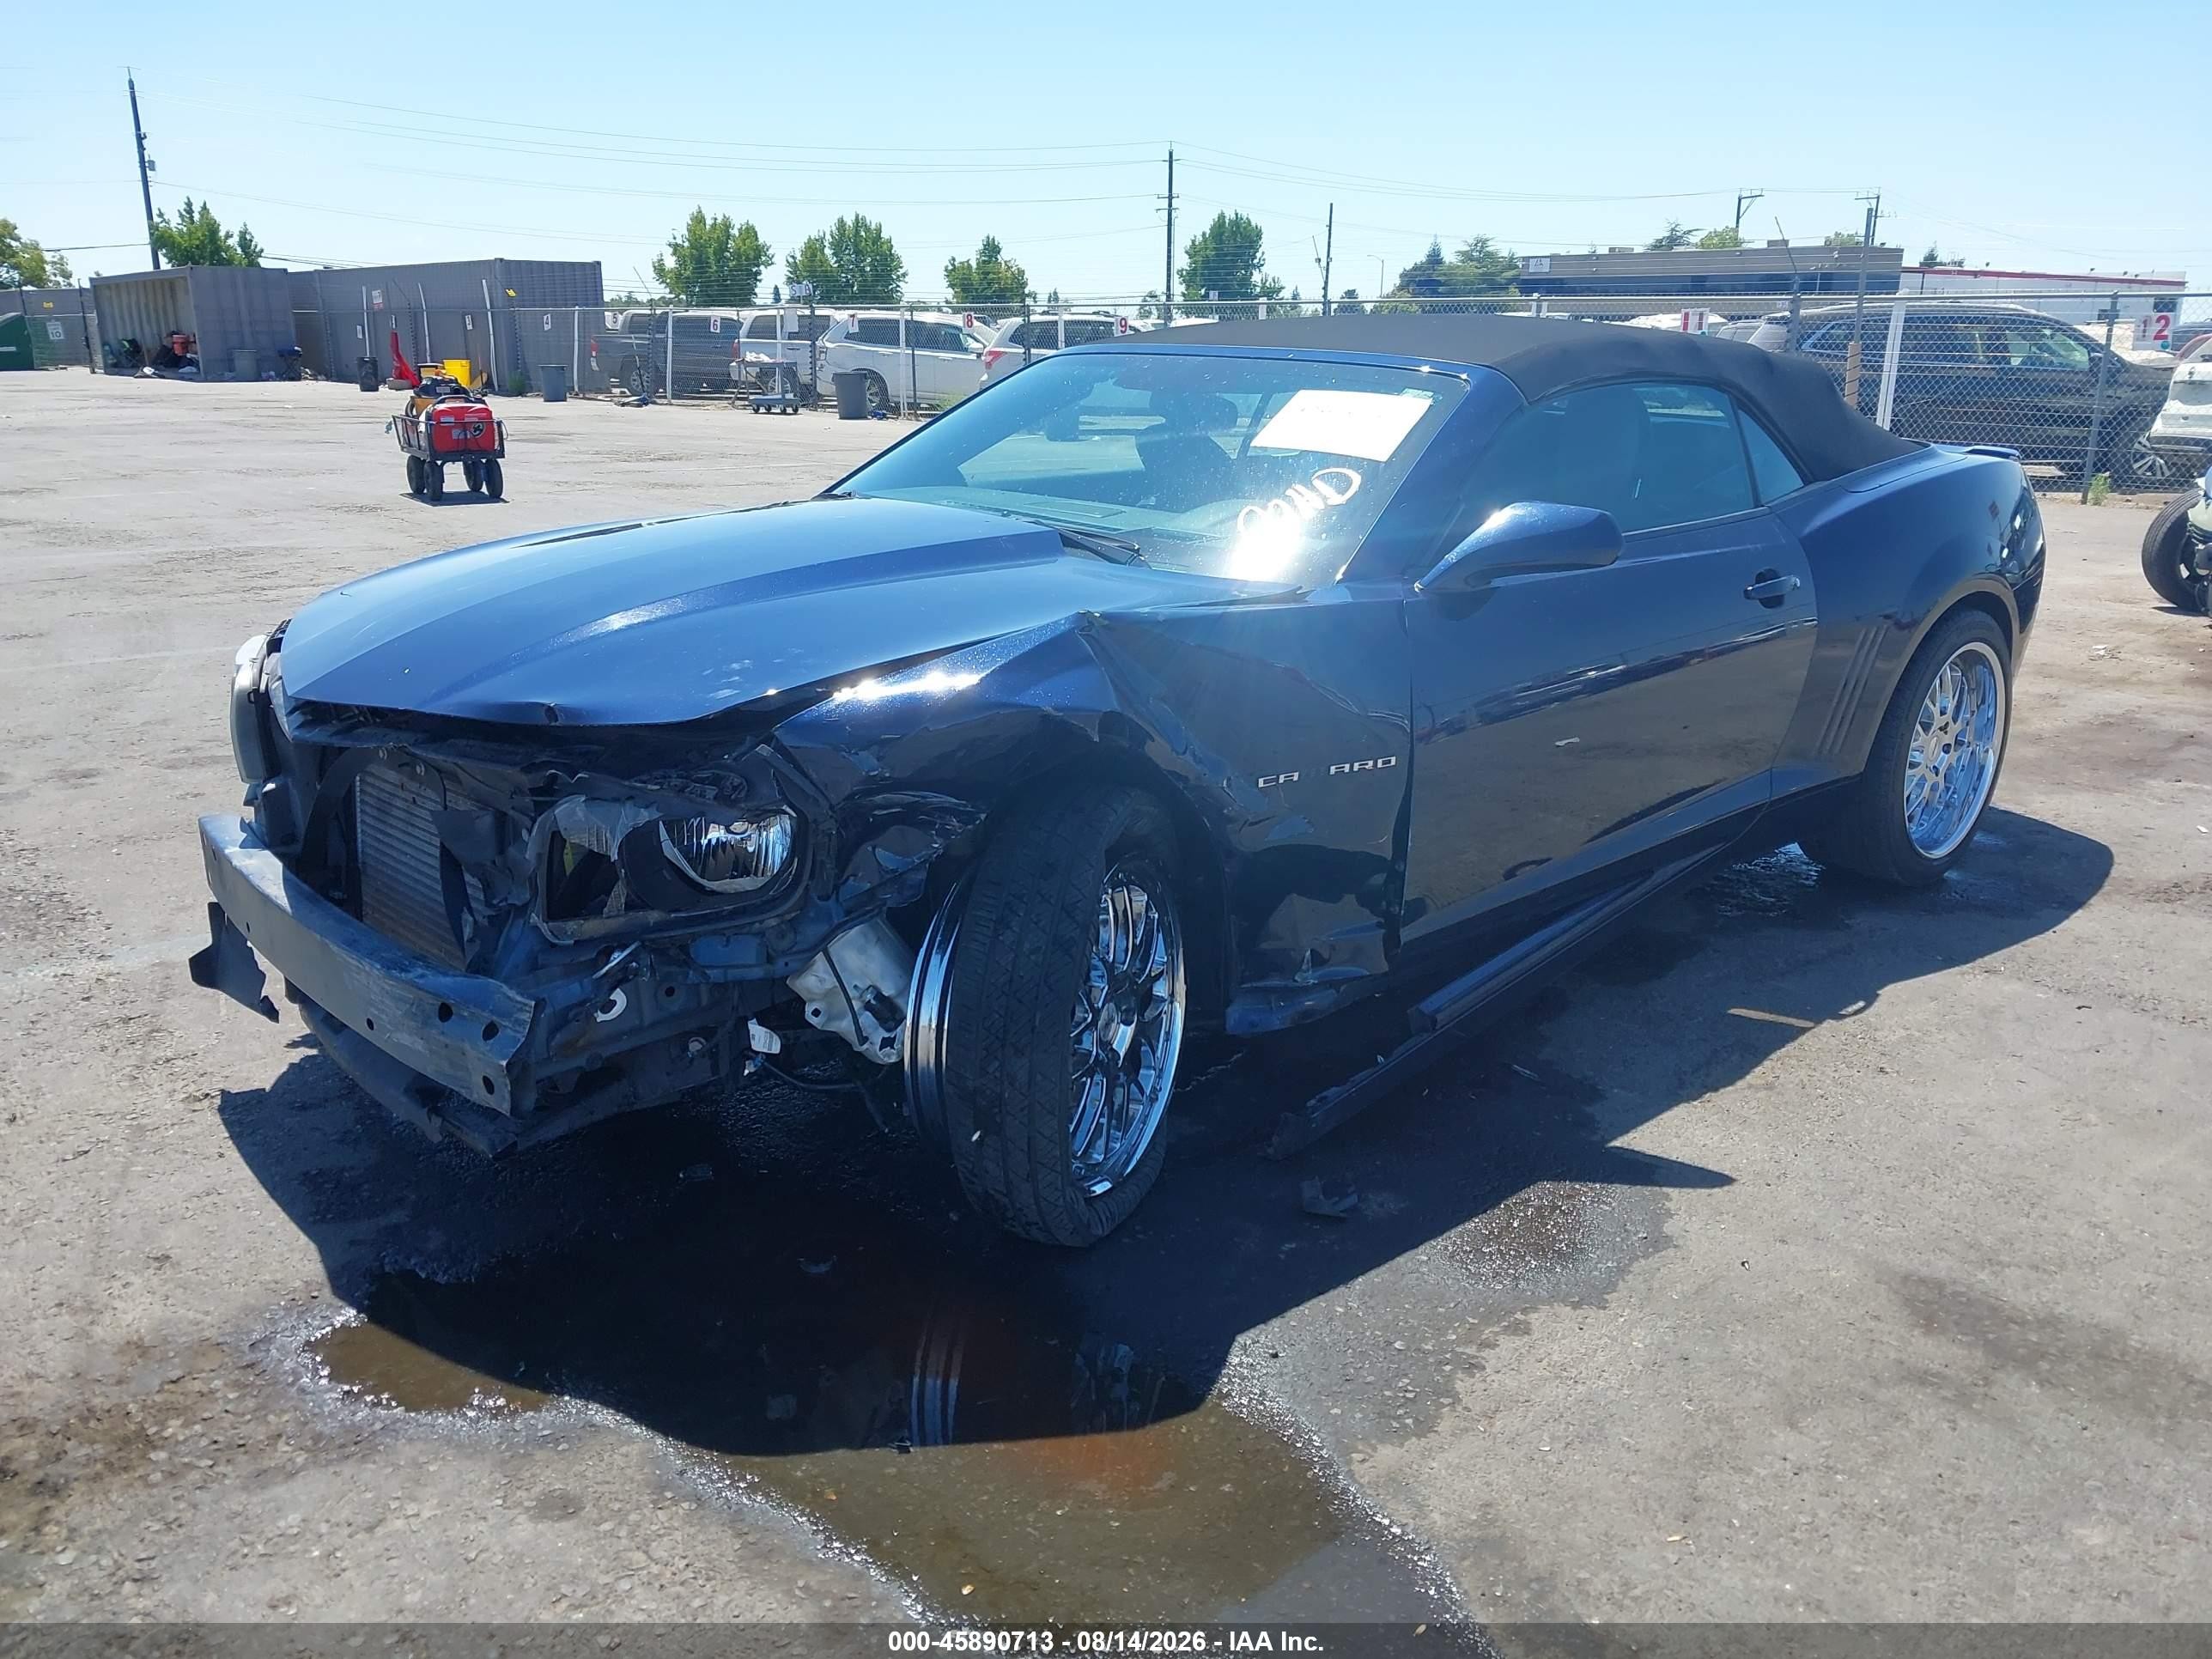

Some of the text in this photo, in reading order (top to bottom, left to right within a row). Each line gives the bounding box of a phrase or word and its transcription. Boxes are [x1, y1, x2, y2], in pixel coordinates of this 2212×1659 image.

[612, 313, 617, 325] 5
[713, 319, 718, 331] 6
[849, 313, 855, 328] 7
[966, 313, 974, 328] 8
[1119, 317, 1127, 334] 9
